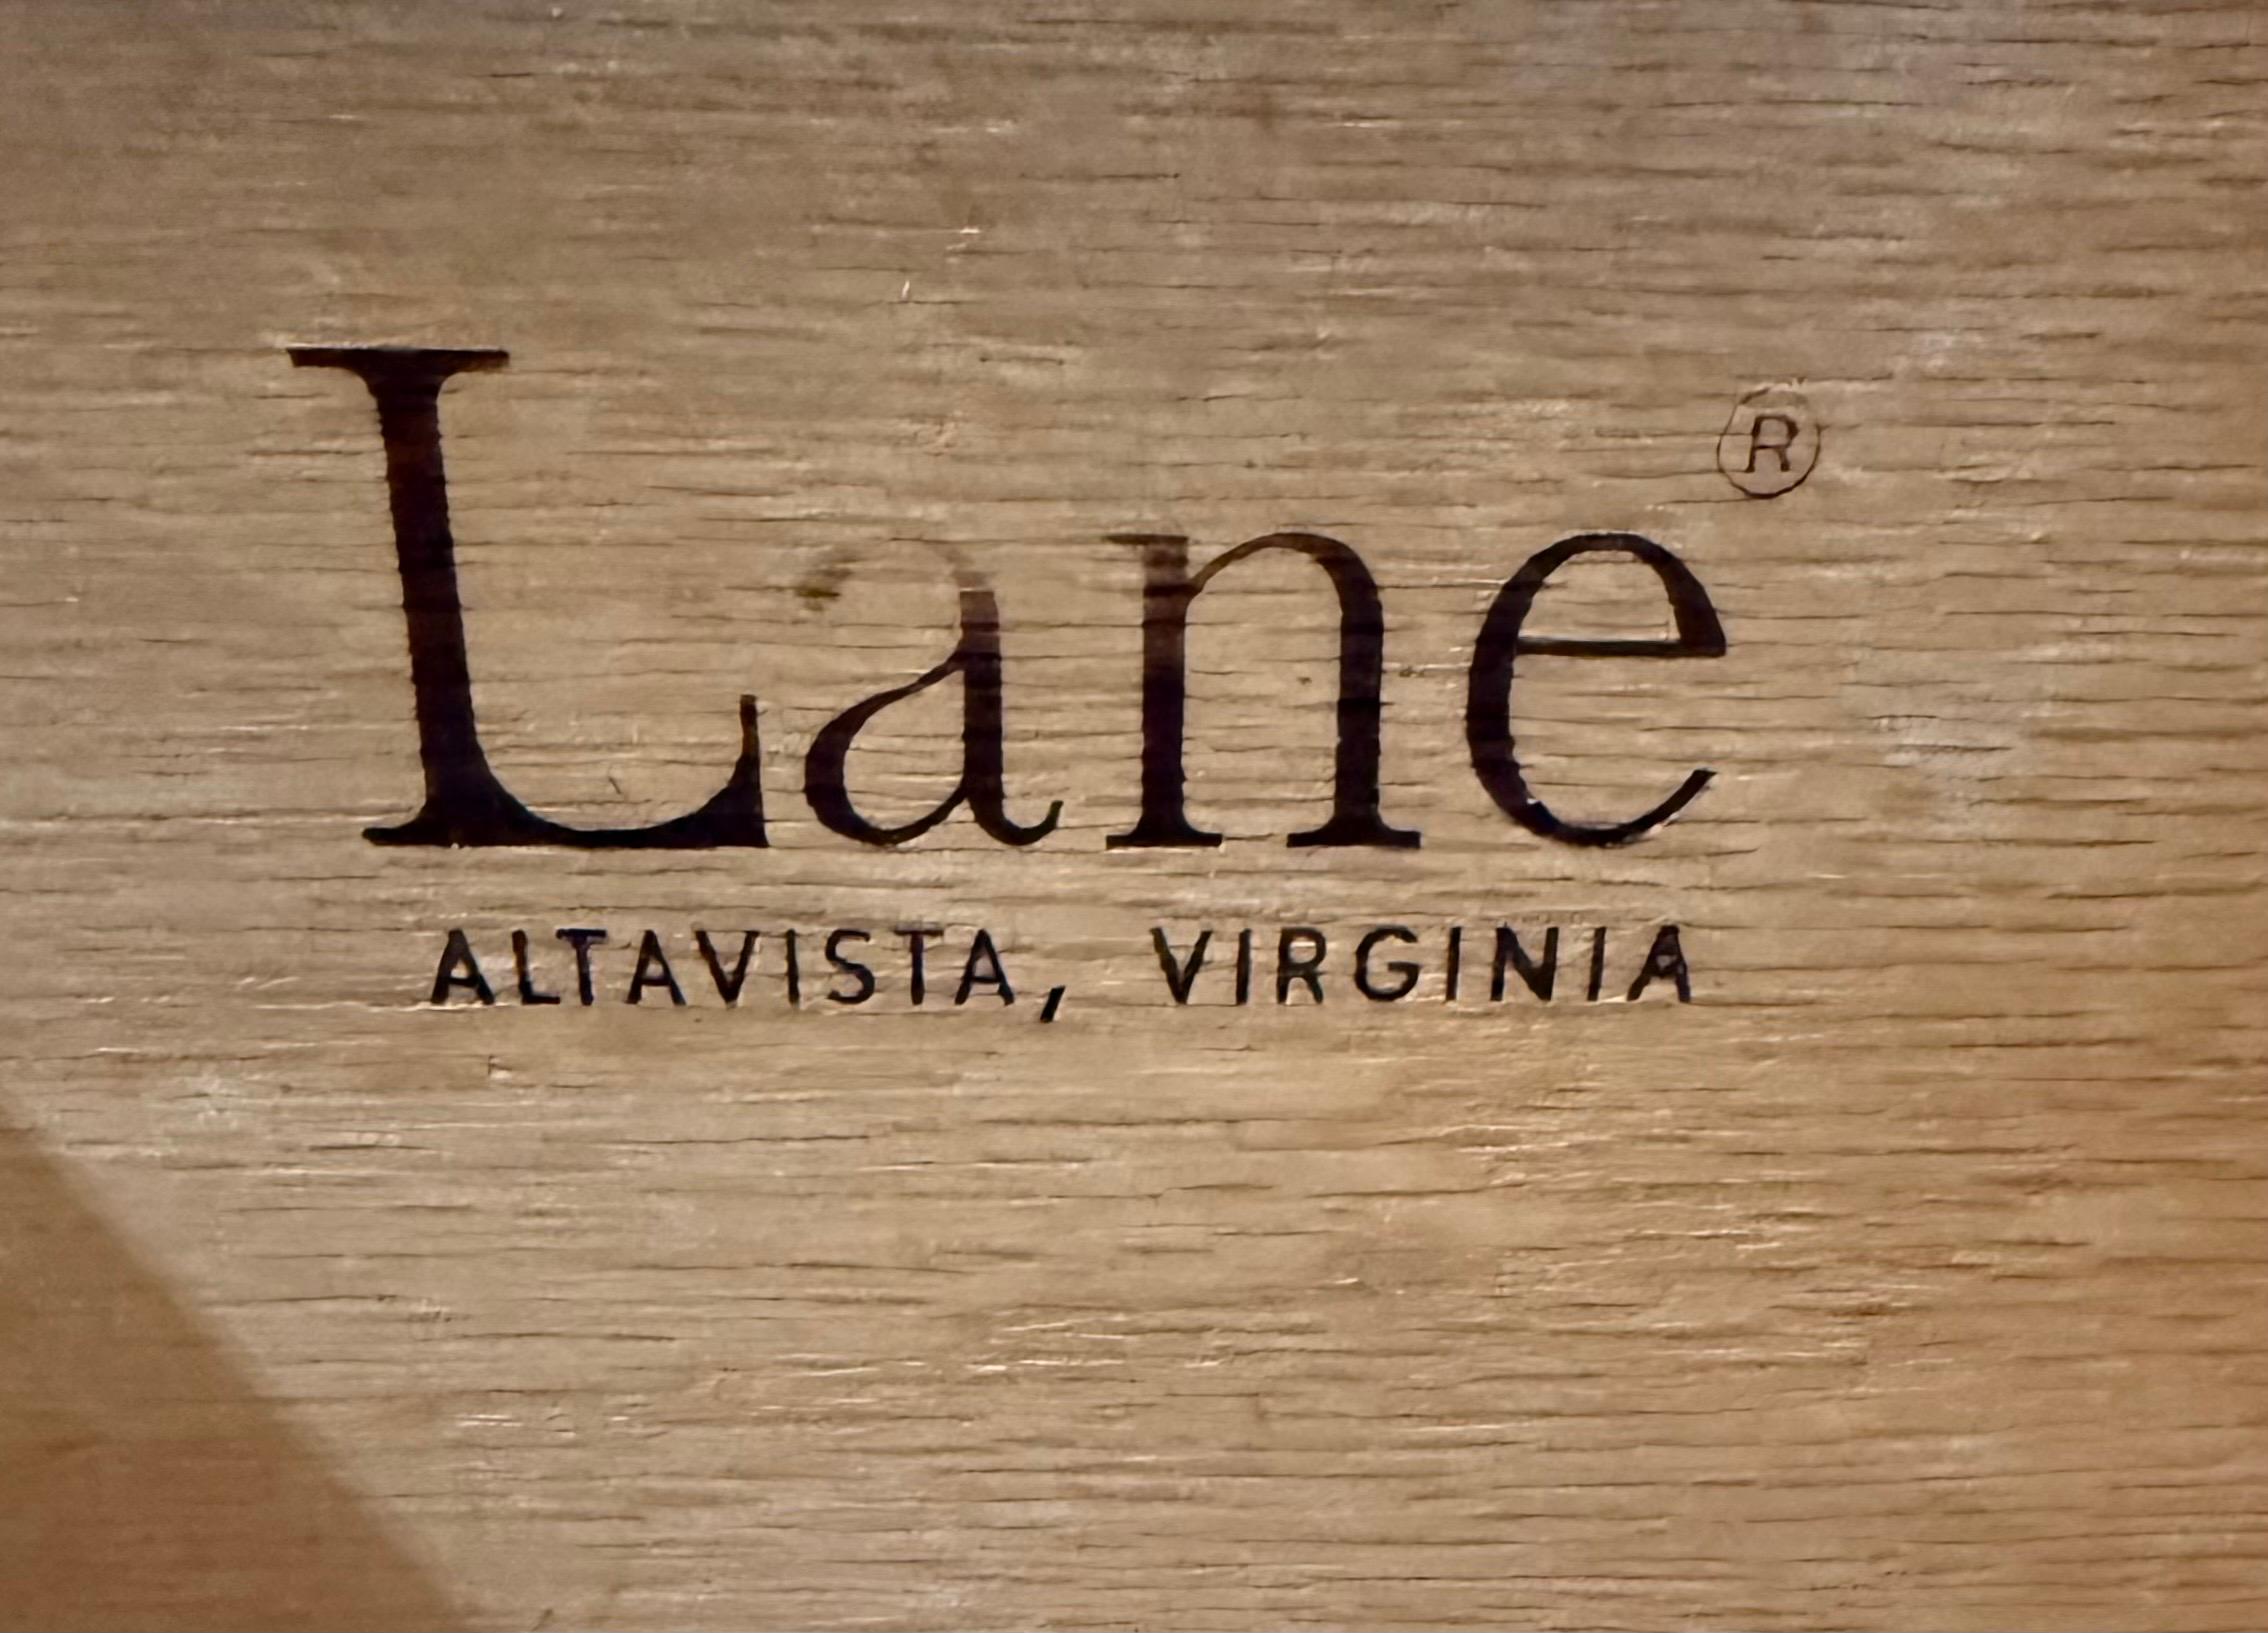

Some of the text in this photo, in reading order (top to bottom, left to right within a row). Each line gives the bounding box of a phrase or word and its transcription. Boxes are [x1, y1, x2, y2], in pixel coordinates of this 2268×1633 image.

[286, 346, 1730, 853] Lane
[427, 922, 1694, 1026] ALTAVISTA, VIRGINIA
